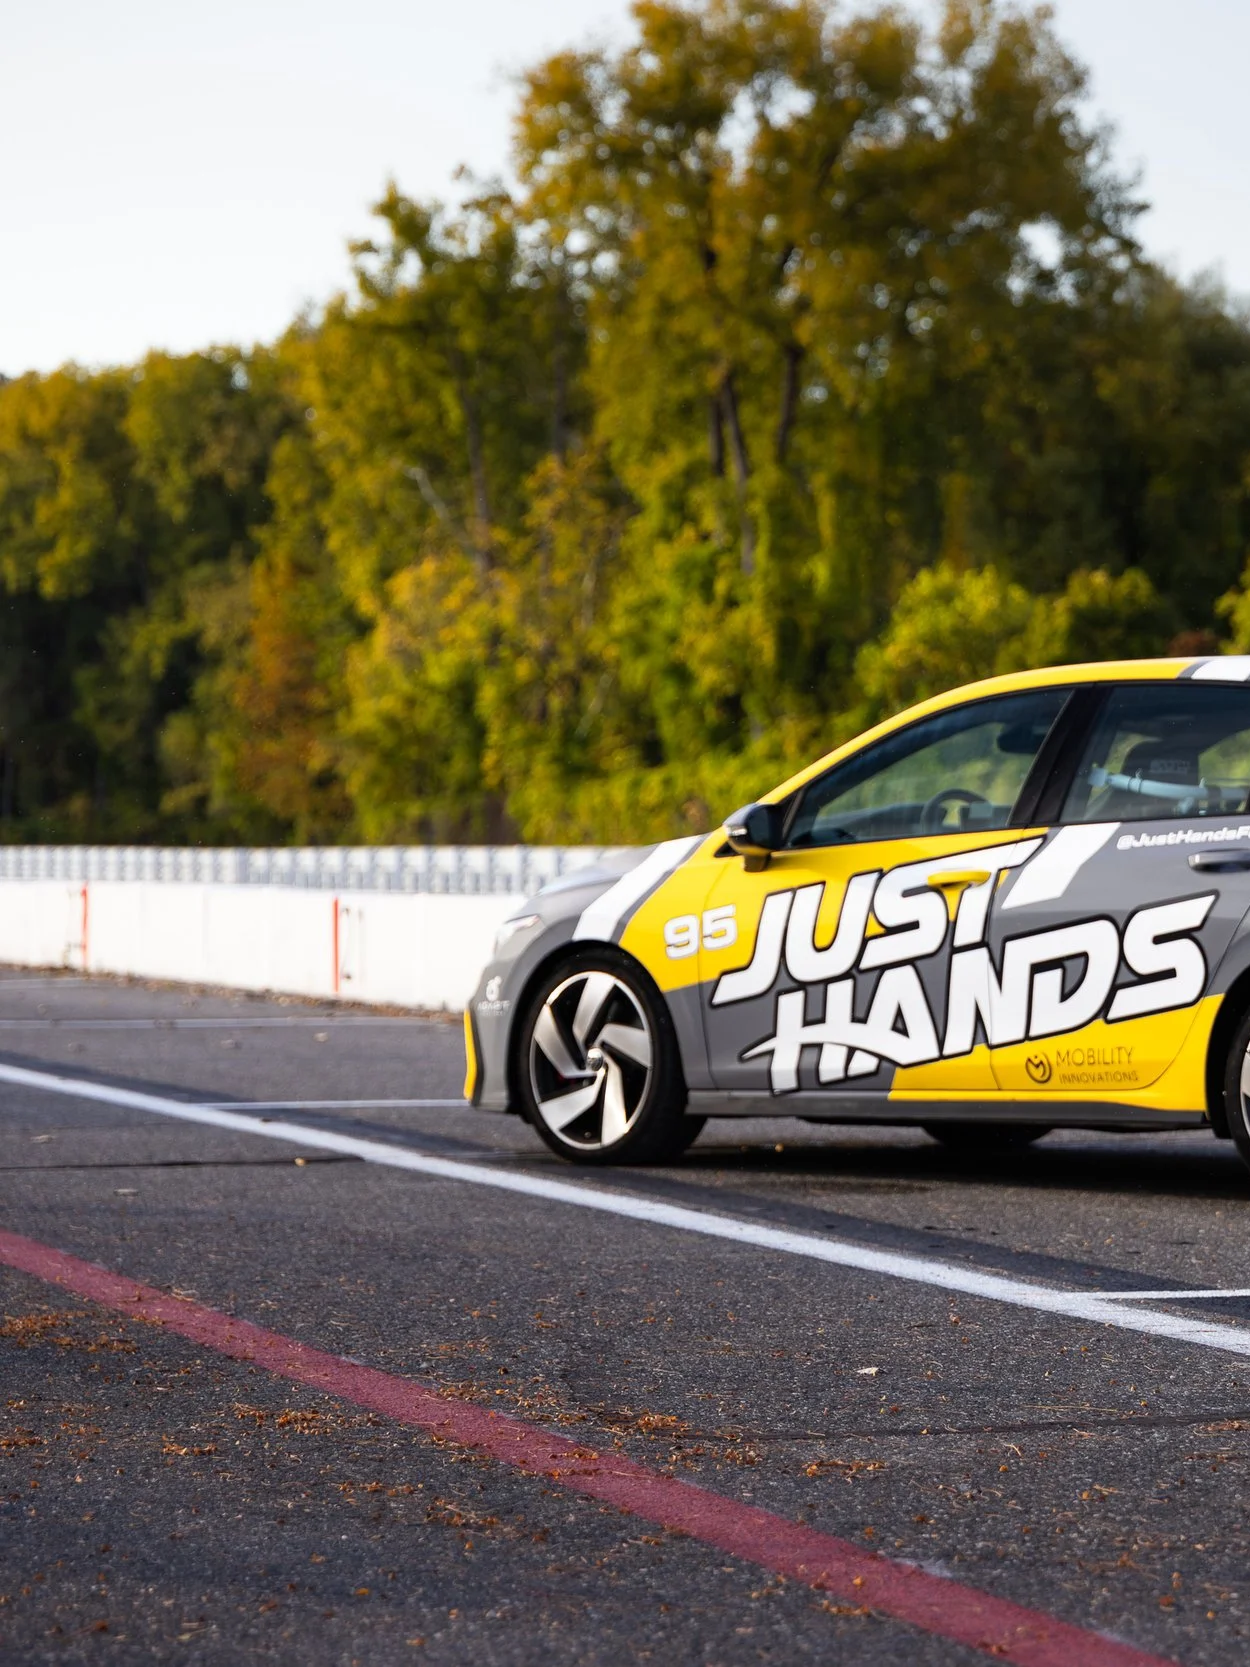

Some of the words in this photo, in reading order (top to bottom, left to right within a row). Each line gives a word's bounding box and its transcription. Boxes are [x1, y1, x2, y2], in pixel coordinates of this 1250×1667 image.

[663, 904, 738, 960] 95
[710, 834, 1047, 1008] JUST
[737, 890, 1219, 1097] HANDS
[1056, 1046, 1134, 1066] MOBILITY
[1058, 1070, 1139, 1085] INNOVATIONS
